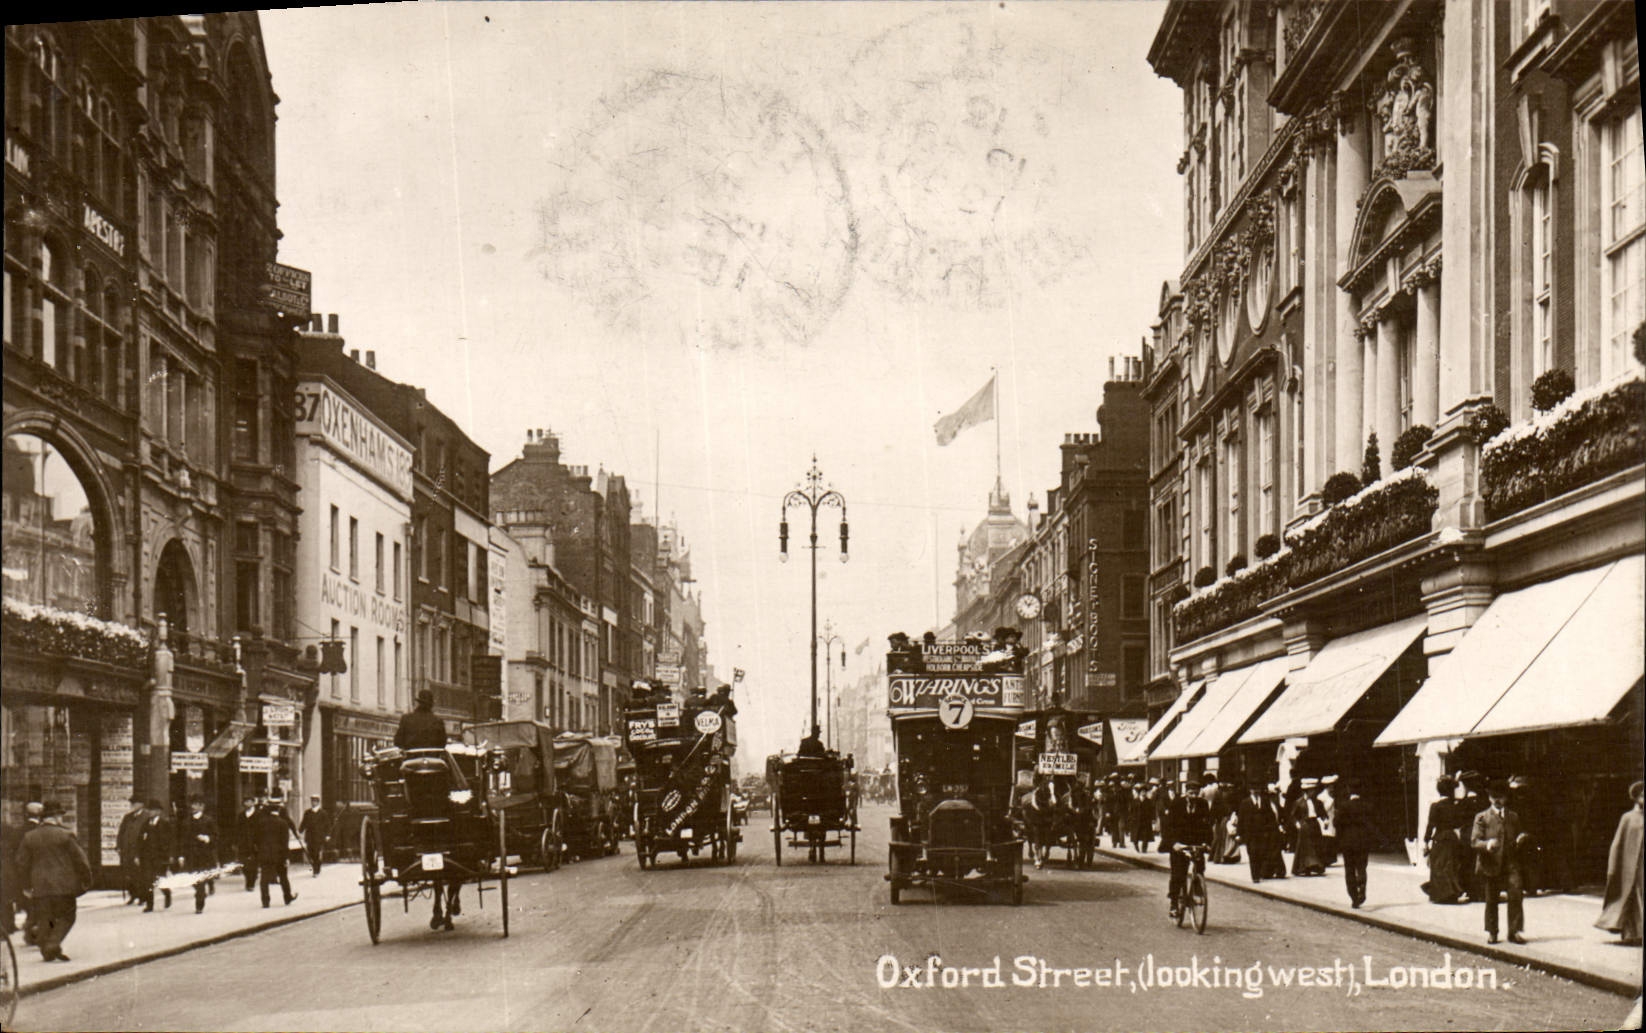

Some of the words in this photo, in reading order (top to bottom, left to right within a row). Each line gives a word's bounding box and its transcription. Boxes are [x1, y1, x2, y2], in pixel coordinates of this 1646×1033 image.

[321, 573, 367, 619] AUCTION
[371, 596, 405, 634] ROOMS
[921, 642, 980, 655] LIVERPOOL
[1088, 612, 1099, 672] BOOTS
[696, 717, 720, 728] VELMA
[949, 704, 965, 725] 7
[665, 799, 699, 837] LONDON
